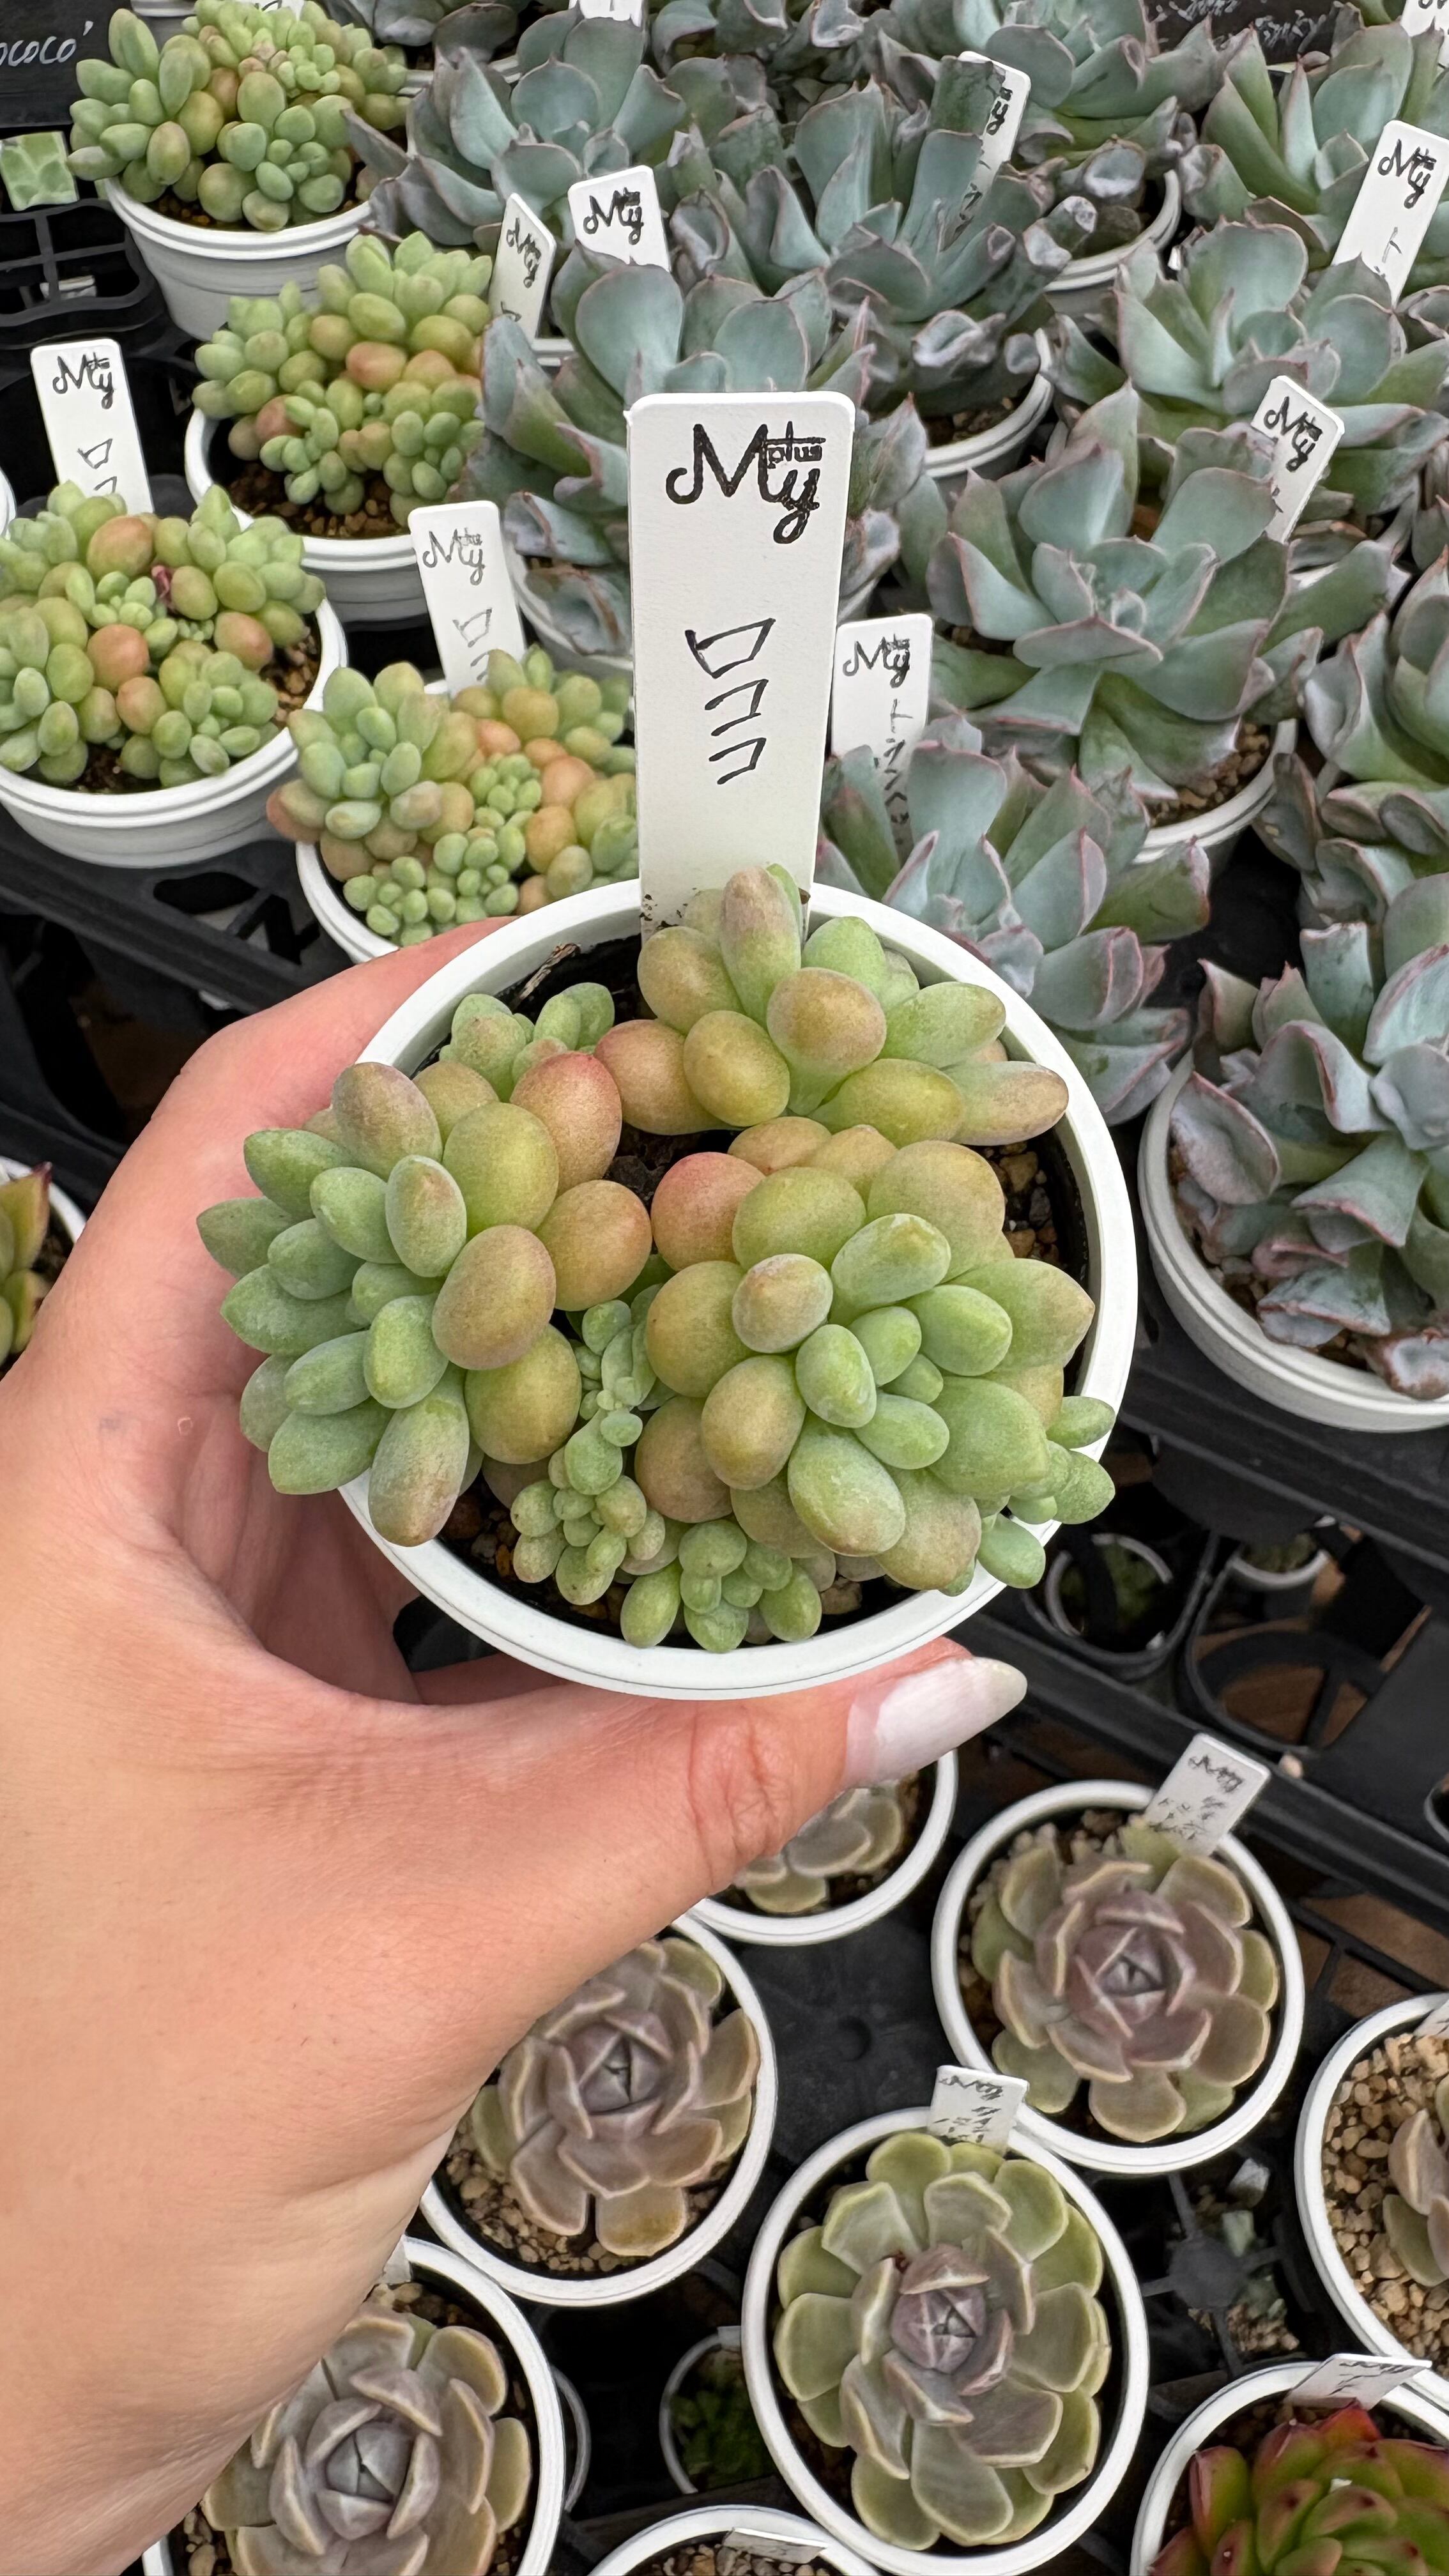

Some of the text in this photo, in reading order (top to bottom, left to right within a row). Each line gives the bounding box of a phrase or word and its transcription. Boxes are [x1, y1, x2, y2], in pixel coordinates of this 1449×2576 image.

[666, 424, 820, 543] My
[685, 617, 776, 784] ロココ
